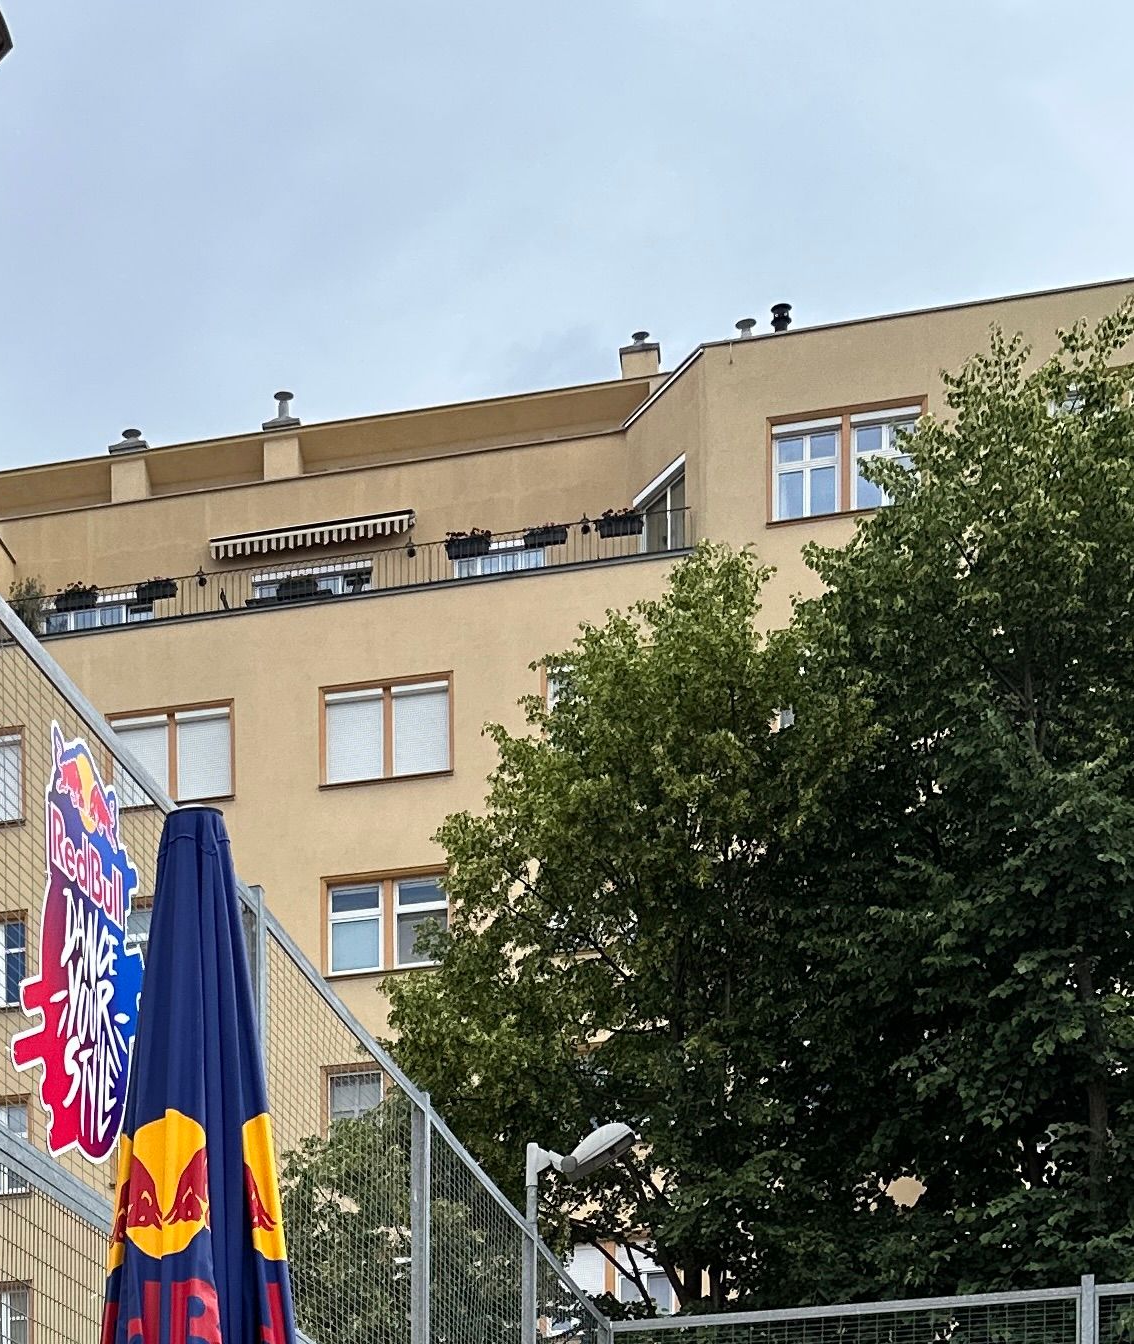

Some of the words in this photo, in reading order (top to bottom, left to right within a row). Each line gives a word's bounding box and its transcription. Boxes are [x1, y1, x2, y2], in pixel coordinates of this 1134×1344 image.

[60, 888, 119, 992] DANCE
[66, 957, 123, 1072] YOUR
[62, 1031, 119, 1144] STYLE
